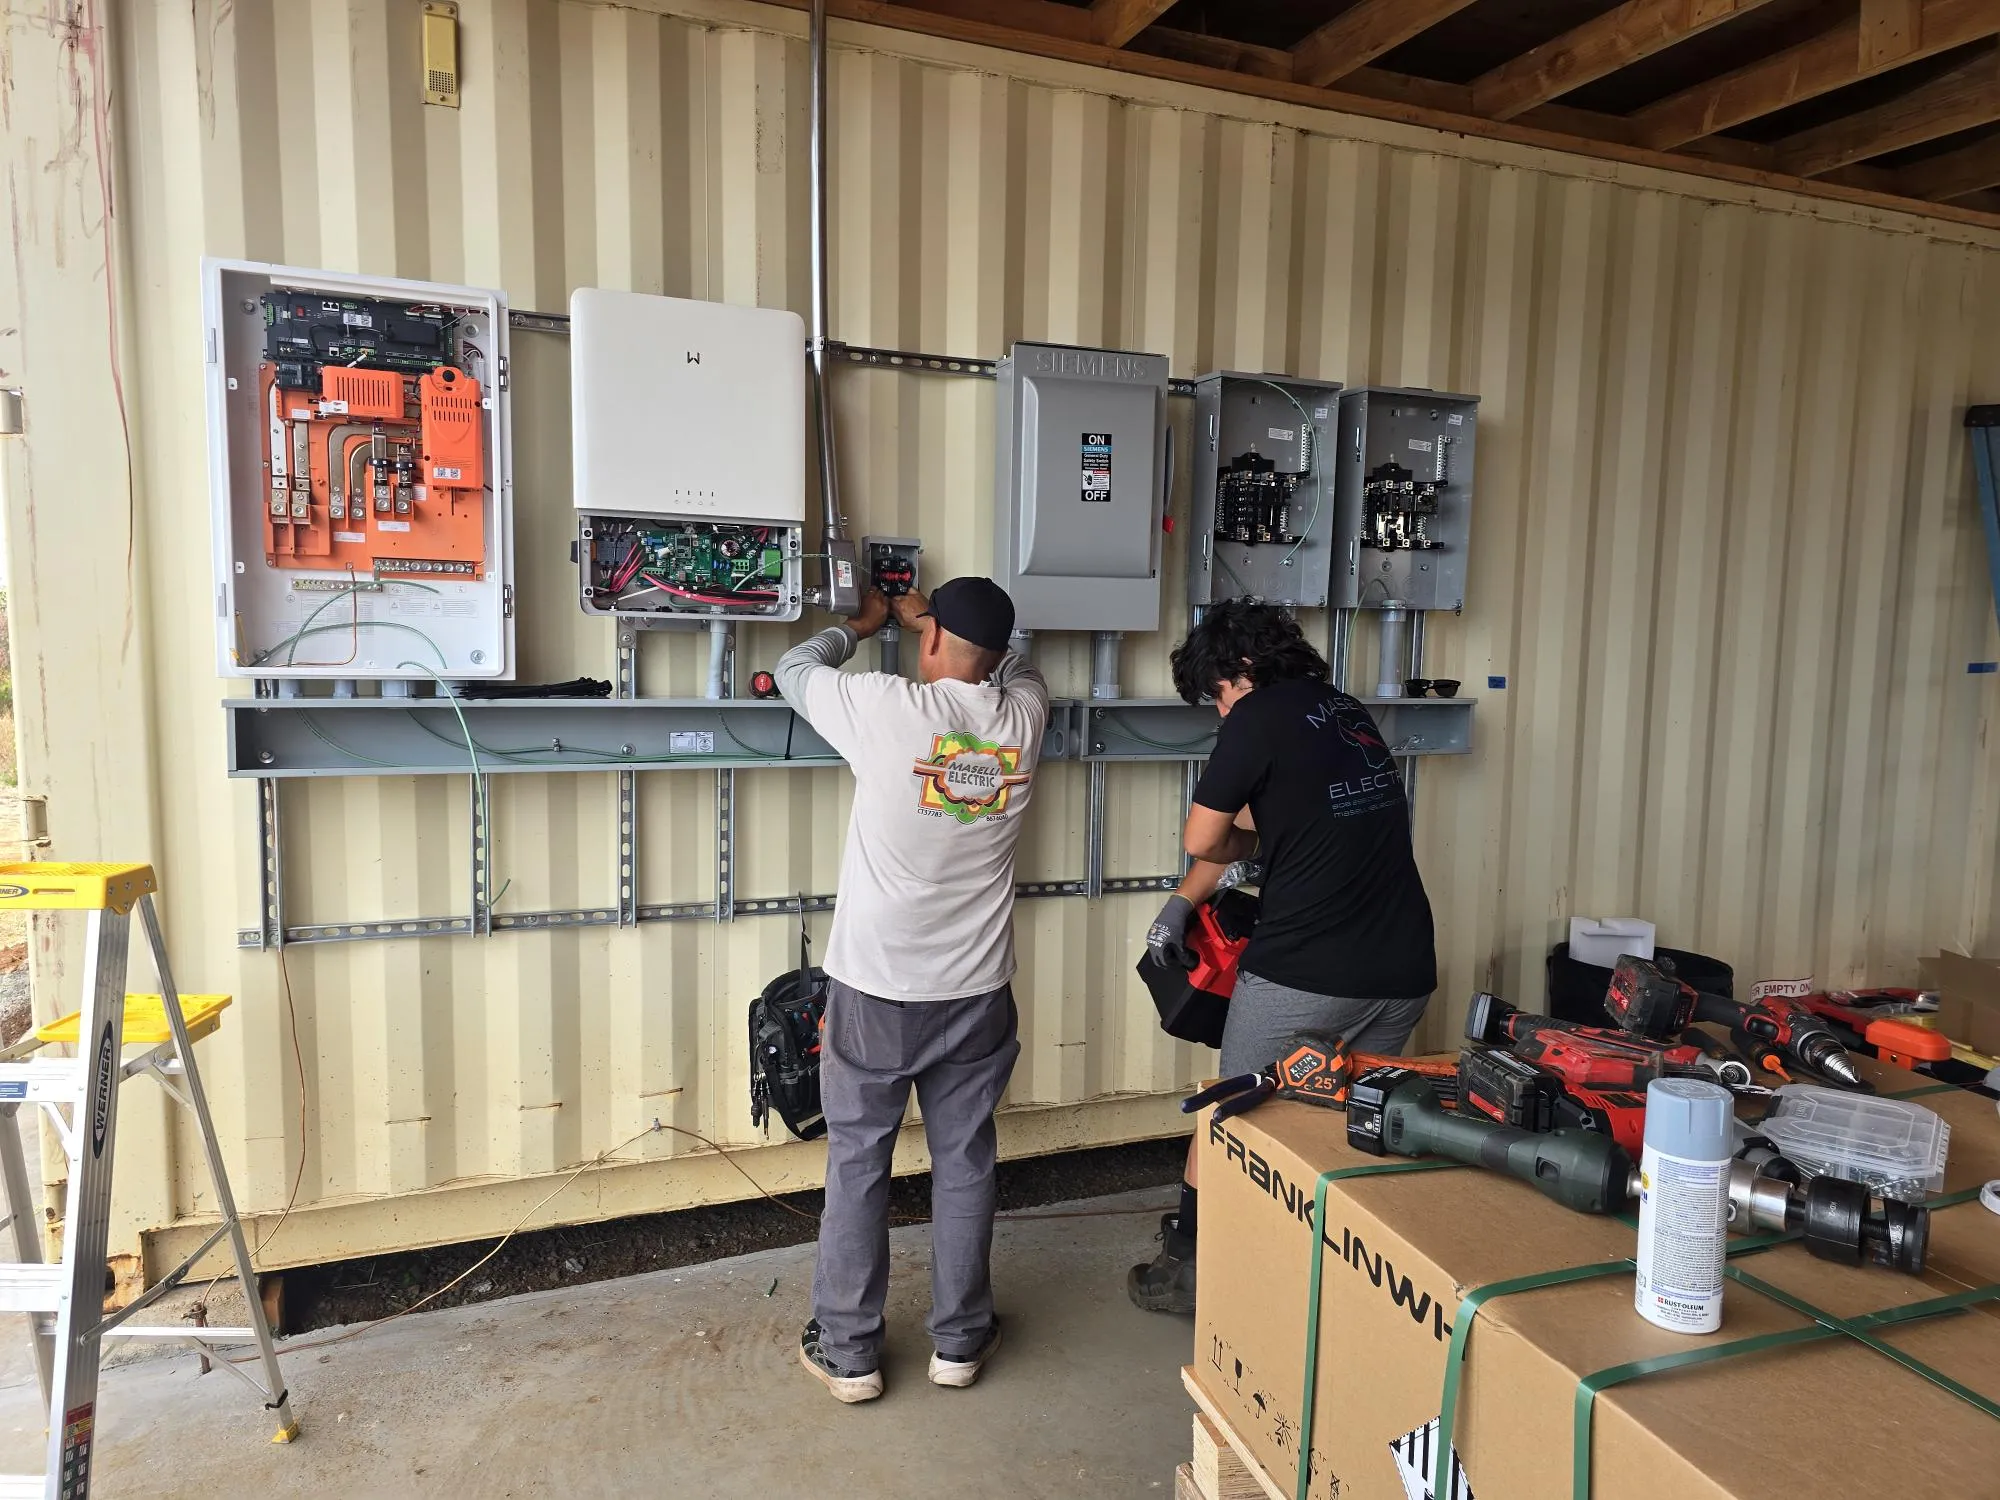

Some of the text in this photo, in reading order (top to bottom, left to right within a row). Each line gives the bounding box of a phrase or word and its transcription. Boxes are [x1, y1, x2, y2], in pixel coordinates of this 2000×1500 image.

[1036, 352, 1147, 379] SIEMENS
[1088, 434, 1105, 445] ON
[1085, 490, 1108, 501] OFF
[948, 761, 1001, 777] MASELLI
[947, 770, 996, 788] ELECTRIC
[1763, 984, 1797, 995] EMPTY
[1290, 1054, 1314, 1075] KLEIN
[1294, 1060, 1318, 1079] TOOLS
[95, 1045, 112, 1131] WERNER
